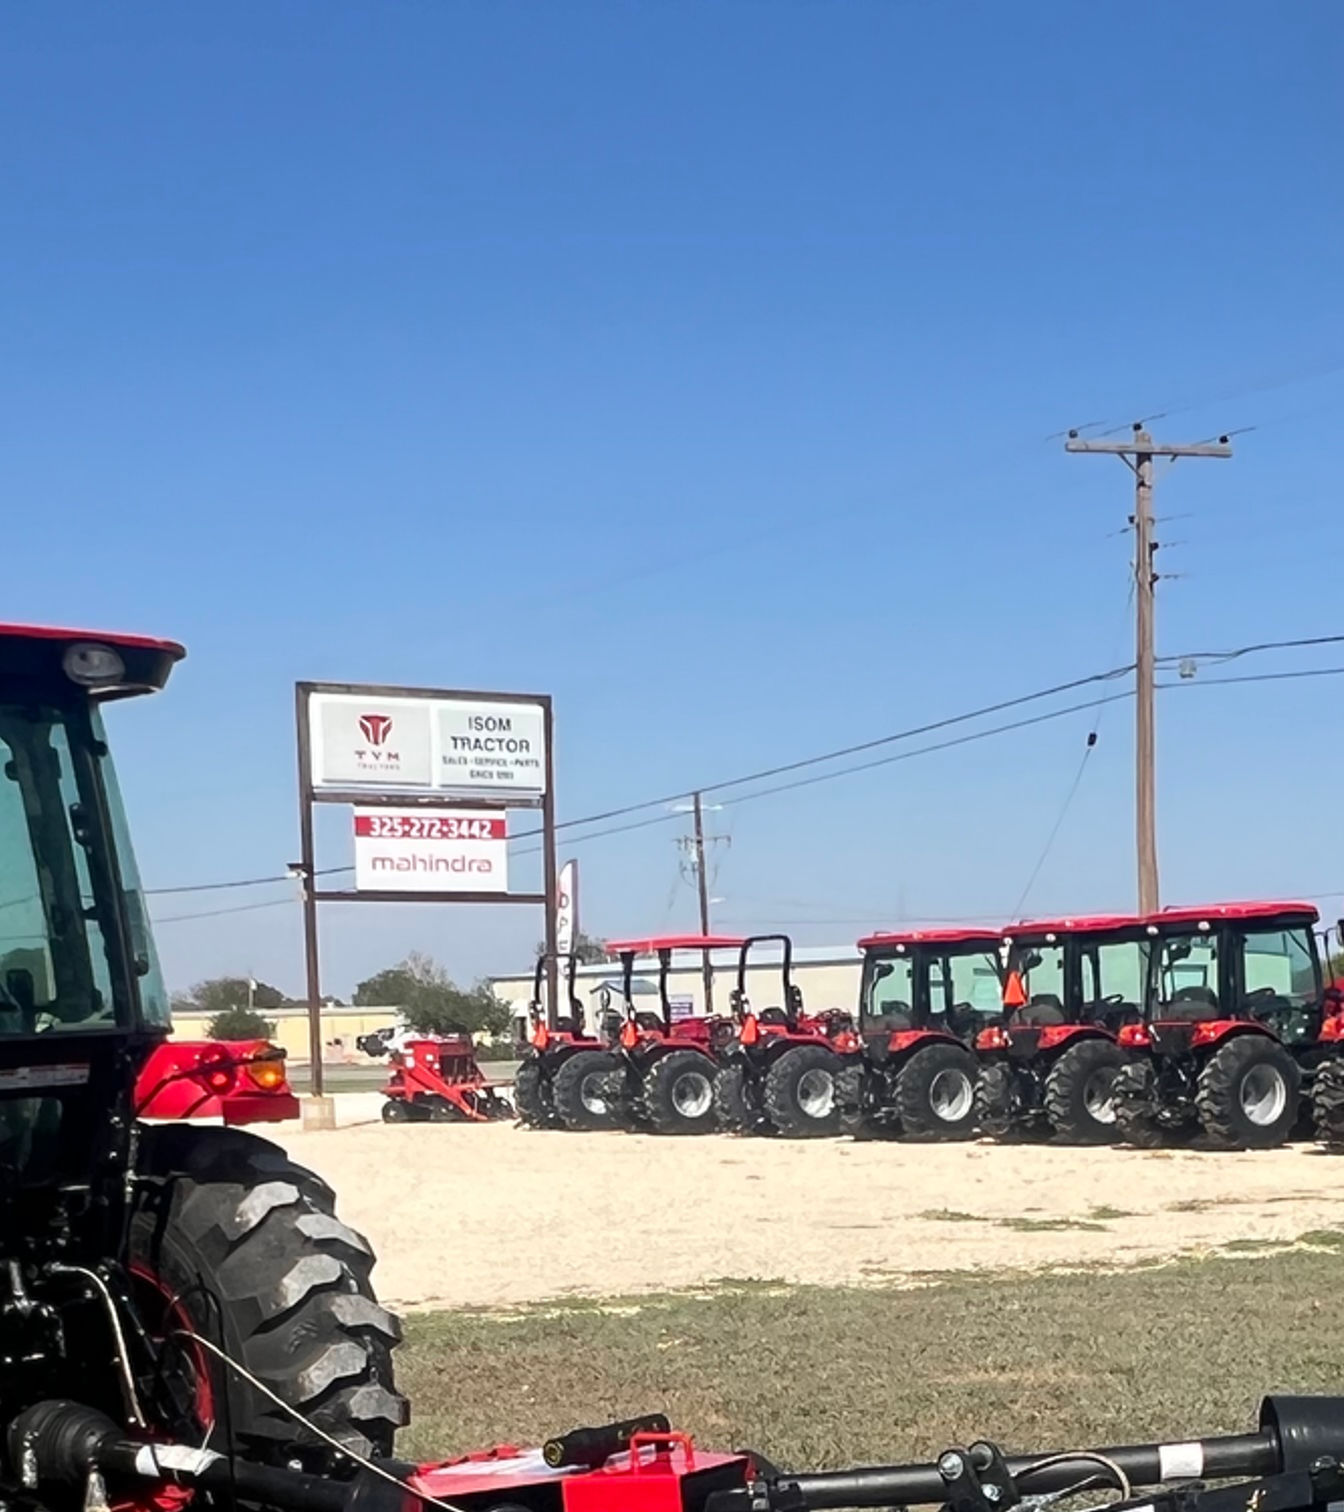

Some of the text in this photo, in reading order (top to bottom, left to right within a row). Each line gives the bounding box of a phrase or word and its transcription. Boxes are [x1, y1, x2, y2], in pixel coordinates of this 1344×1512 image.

[469, 716, 512, 732] ISOM
[451, 736, 530, 753] TRACTOR
[354, 750, 400, 761] TYM
[372, 854, 492, 872] mahindra
